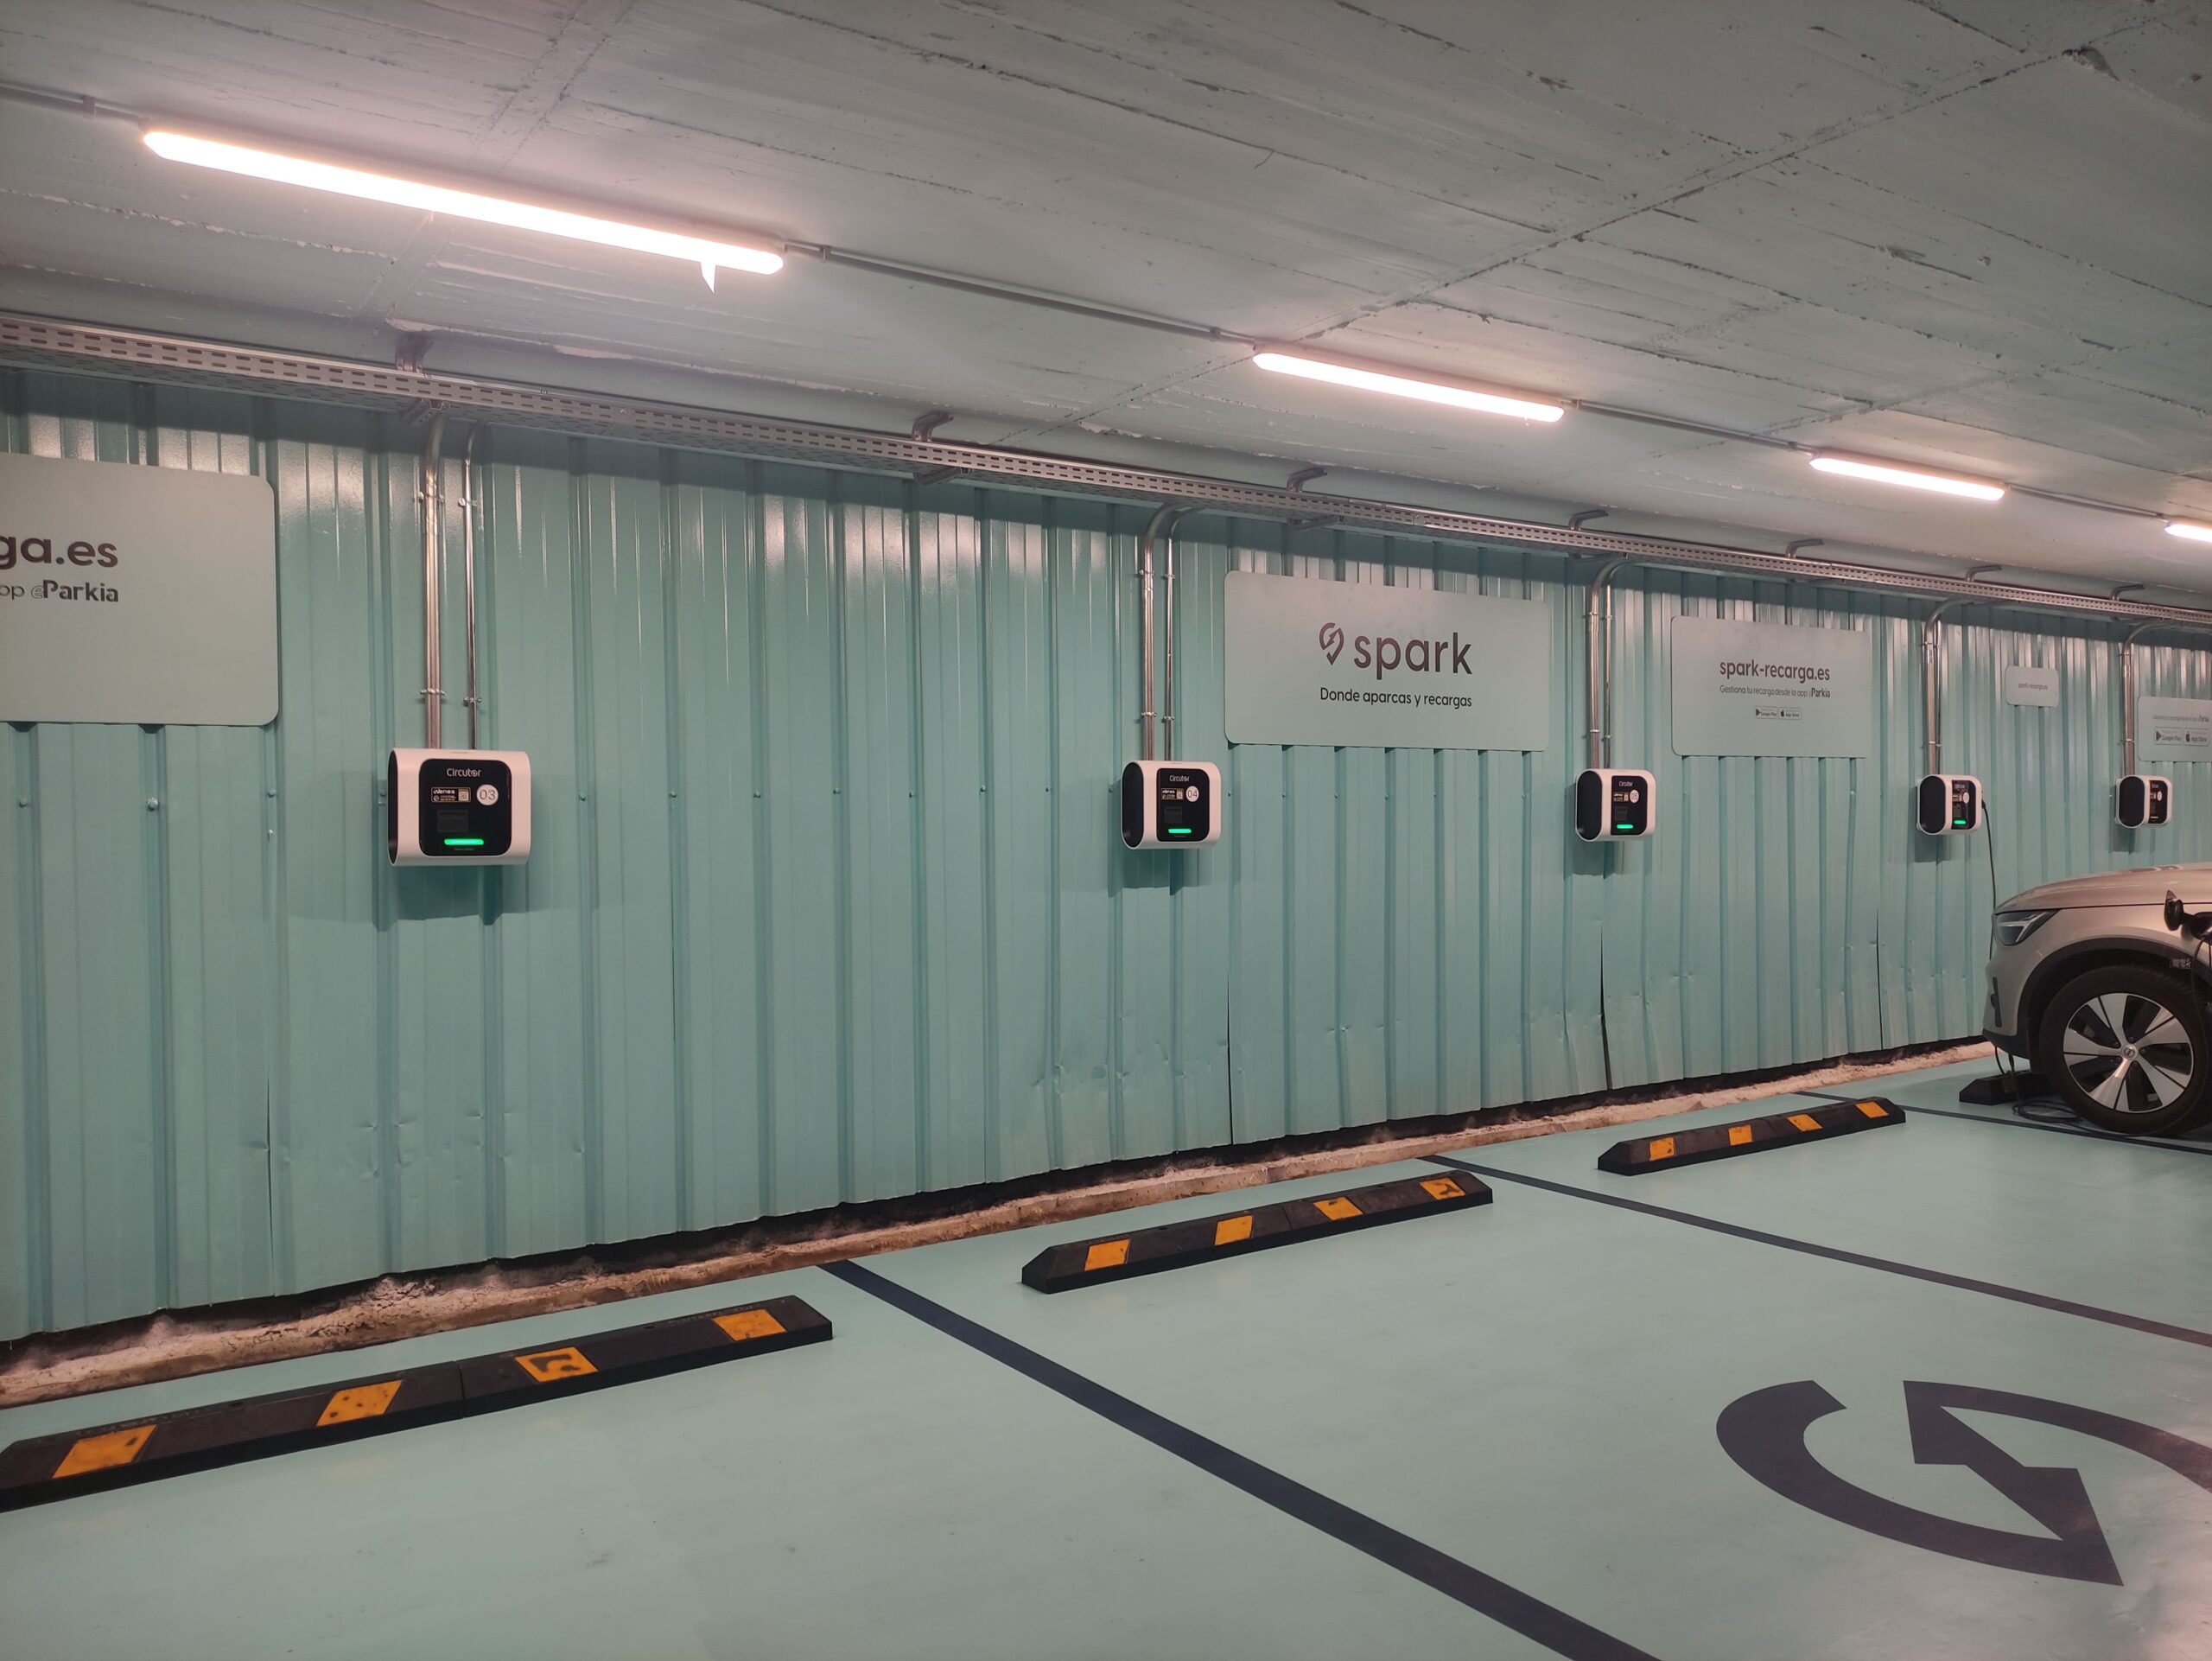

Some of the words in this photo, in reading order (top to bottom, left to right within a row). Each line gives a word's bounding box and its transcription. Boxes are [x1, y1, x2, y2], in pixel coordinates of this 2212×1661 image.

[1353, 632, 1472, 680] spark
[1719, 659, 1830, 684] spark-recarga.es
[1753, 688, 1775, 697] recarga
[1775, 687, 1790, 696] desde
[1320, 687, 1360, 702] Donde
[1363, 691, 1412, 705] aparcas
[1414, 694, 1421, 708] y
[1424, 695, 1472, 710] recargas
[446, 767, 482, 777] Circutor
[480, 789, 496, 800] 03
[1187, 789, 1198, 799] 04
